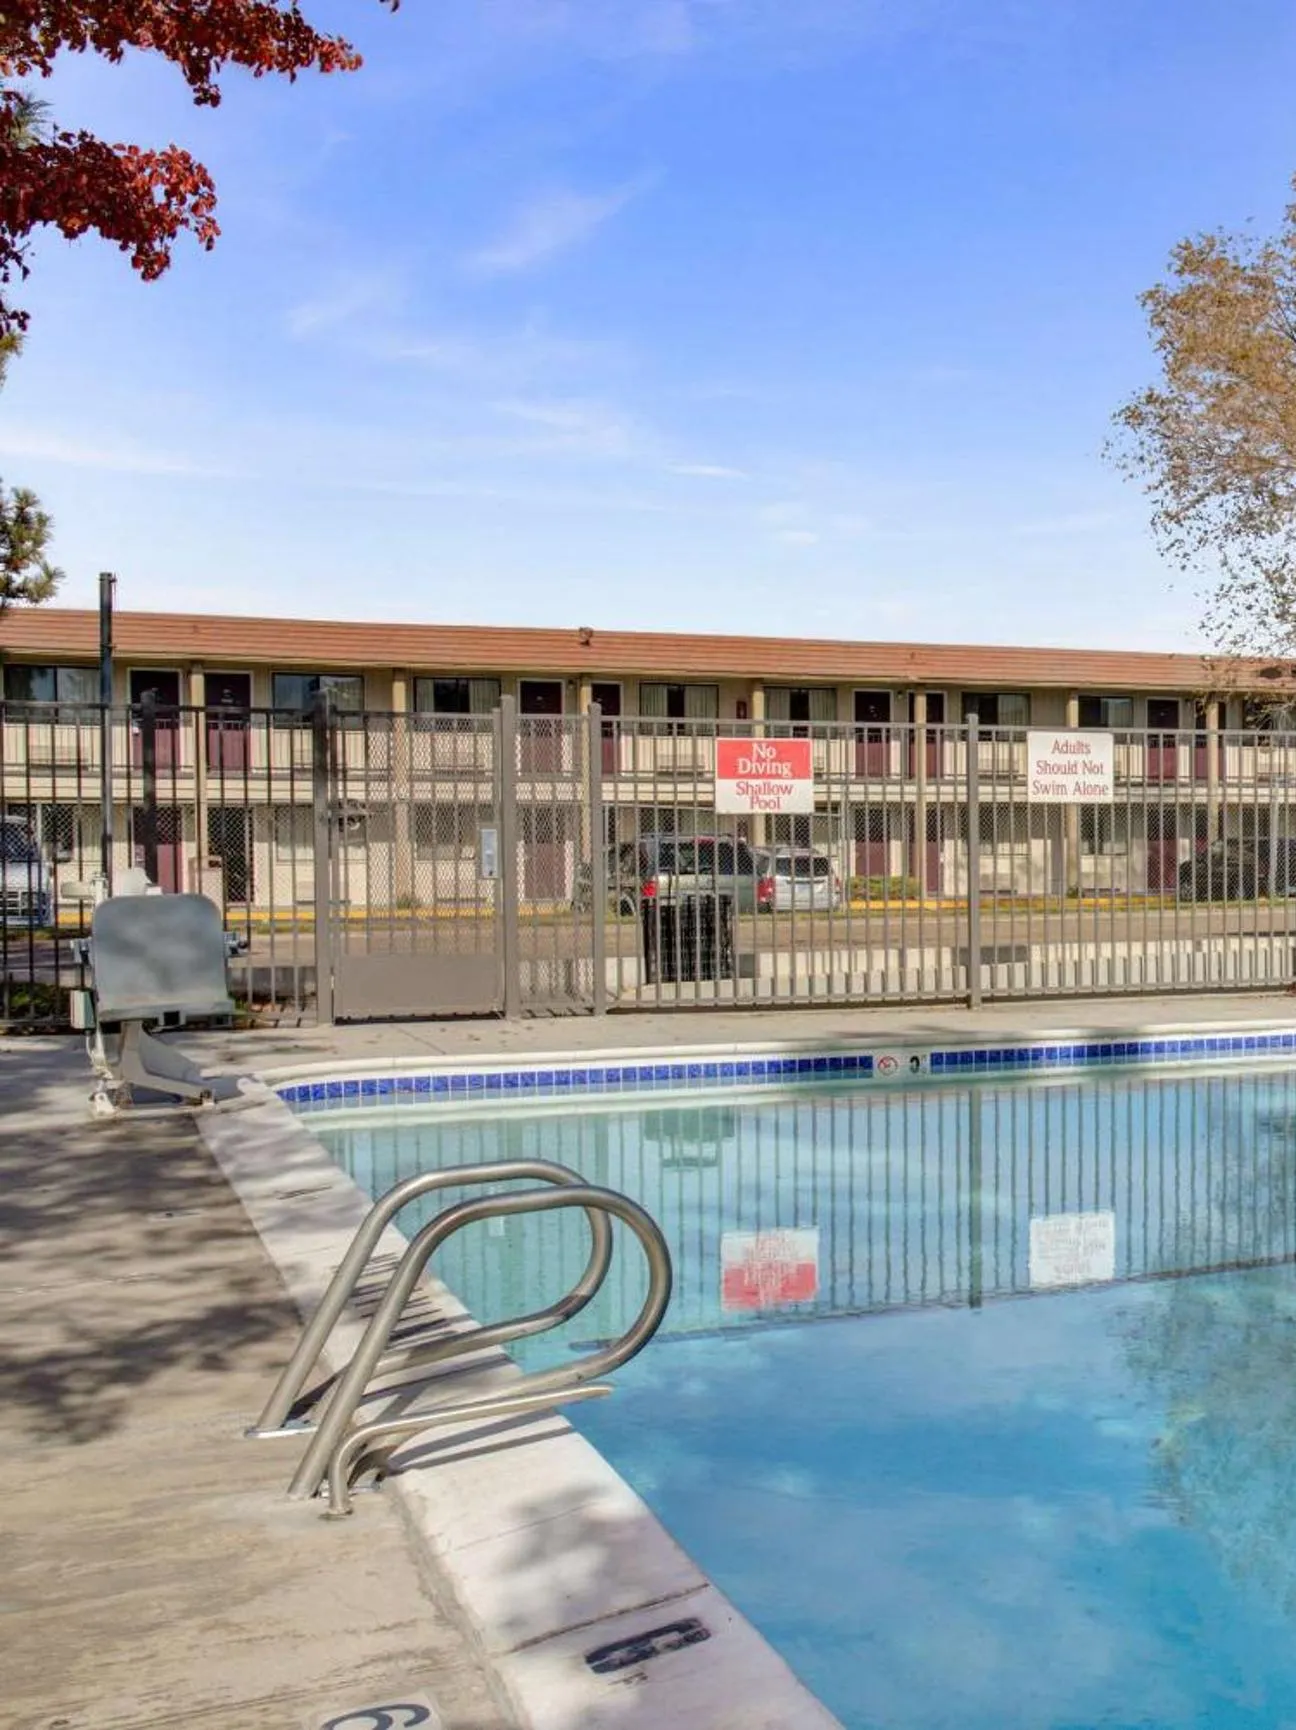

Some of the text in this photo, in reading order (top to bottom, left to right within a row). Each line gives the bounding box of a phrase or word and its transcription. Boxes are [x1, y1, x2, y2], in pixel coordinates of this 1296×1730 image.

[751, 742, 777, 761] No
[1051, 738, 1092, 754] Adults
[736, 758, 793, 778] Diving
[1035, 759, 1104, 775] Should Not
[735, 781, 793, 796] Shallow
[1032, 779, 1109, 796] Swim Alone
[749, 796, 781, 810] Pool
